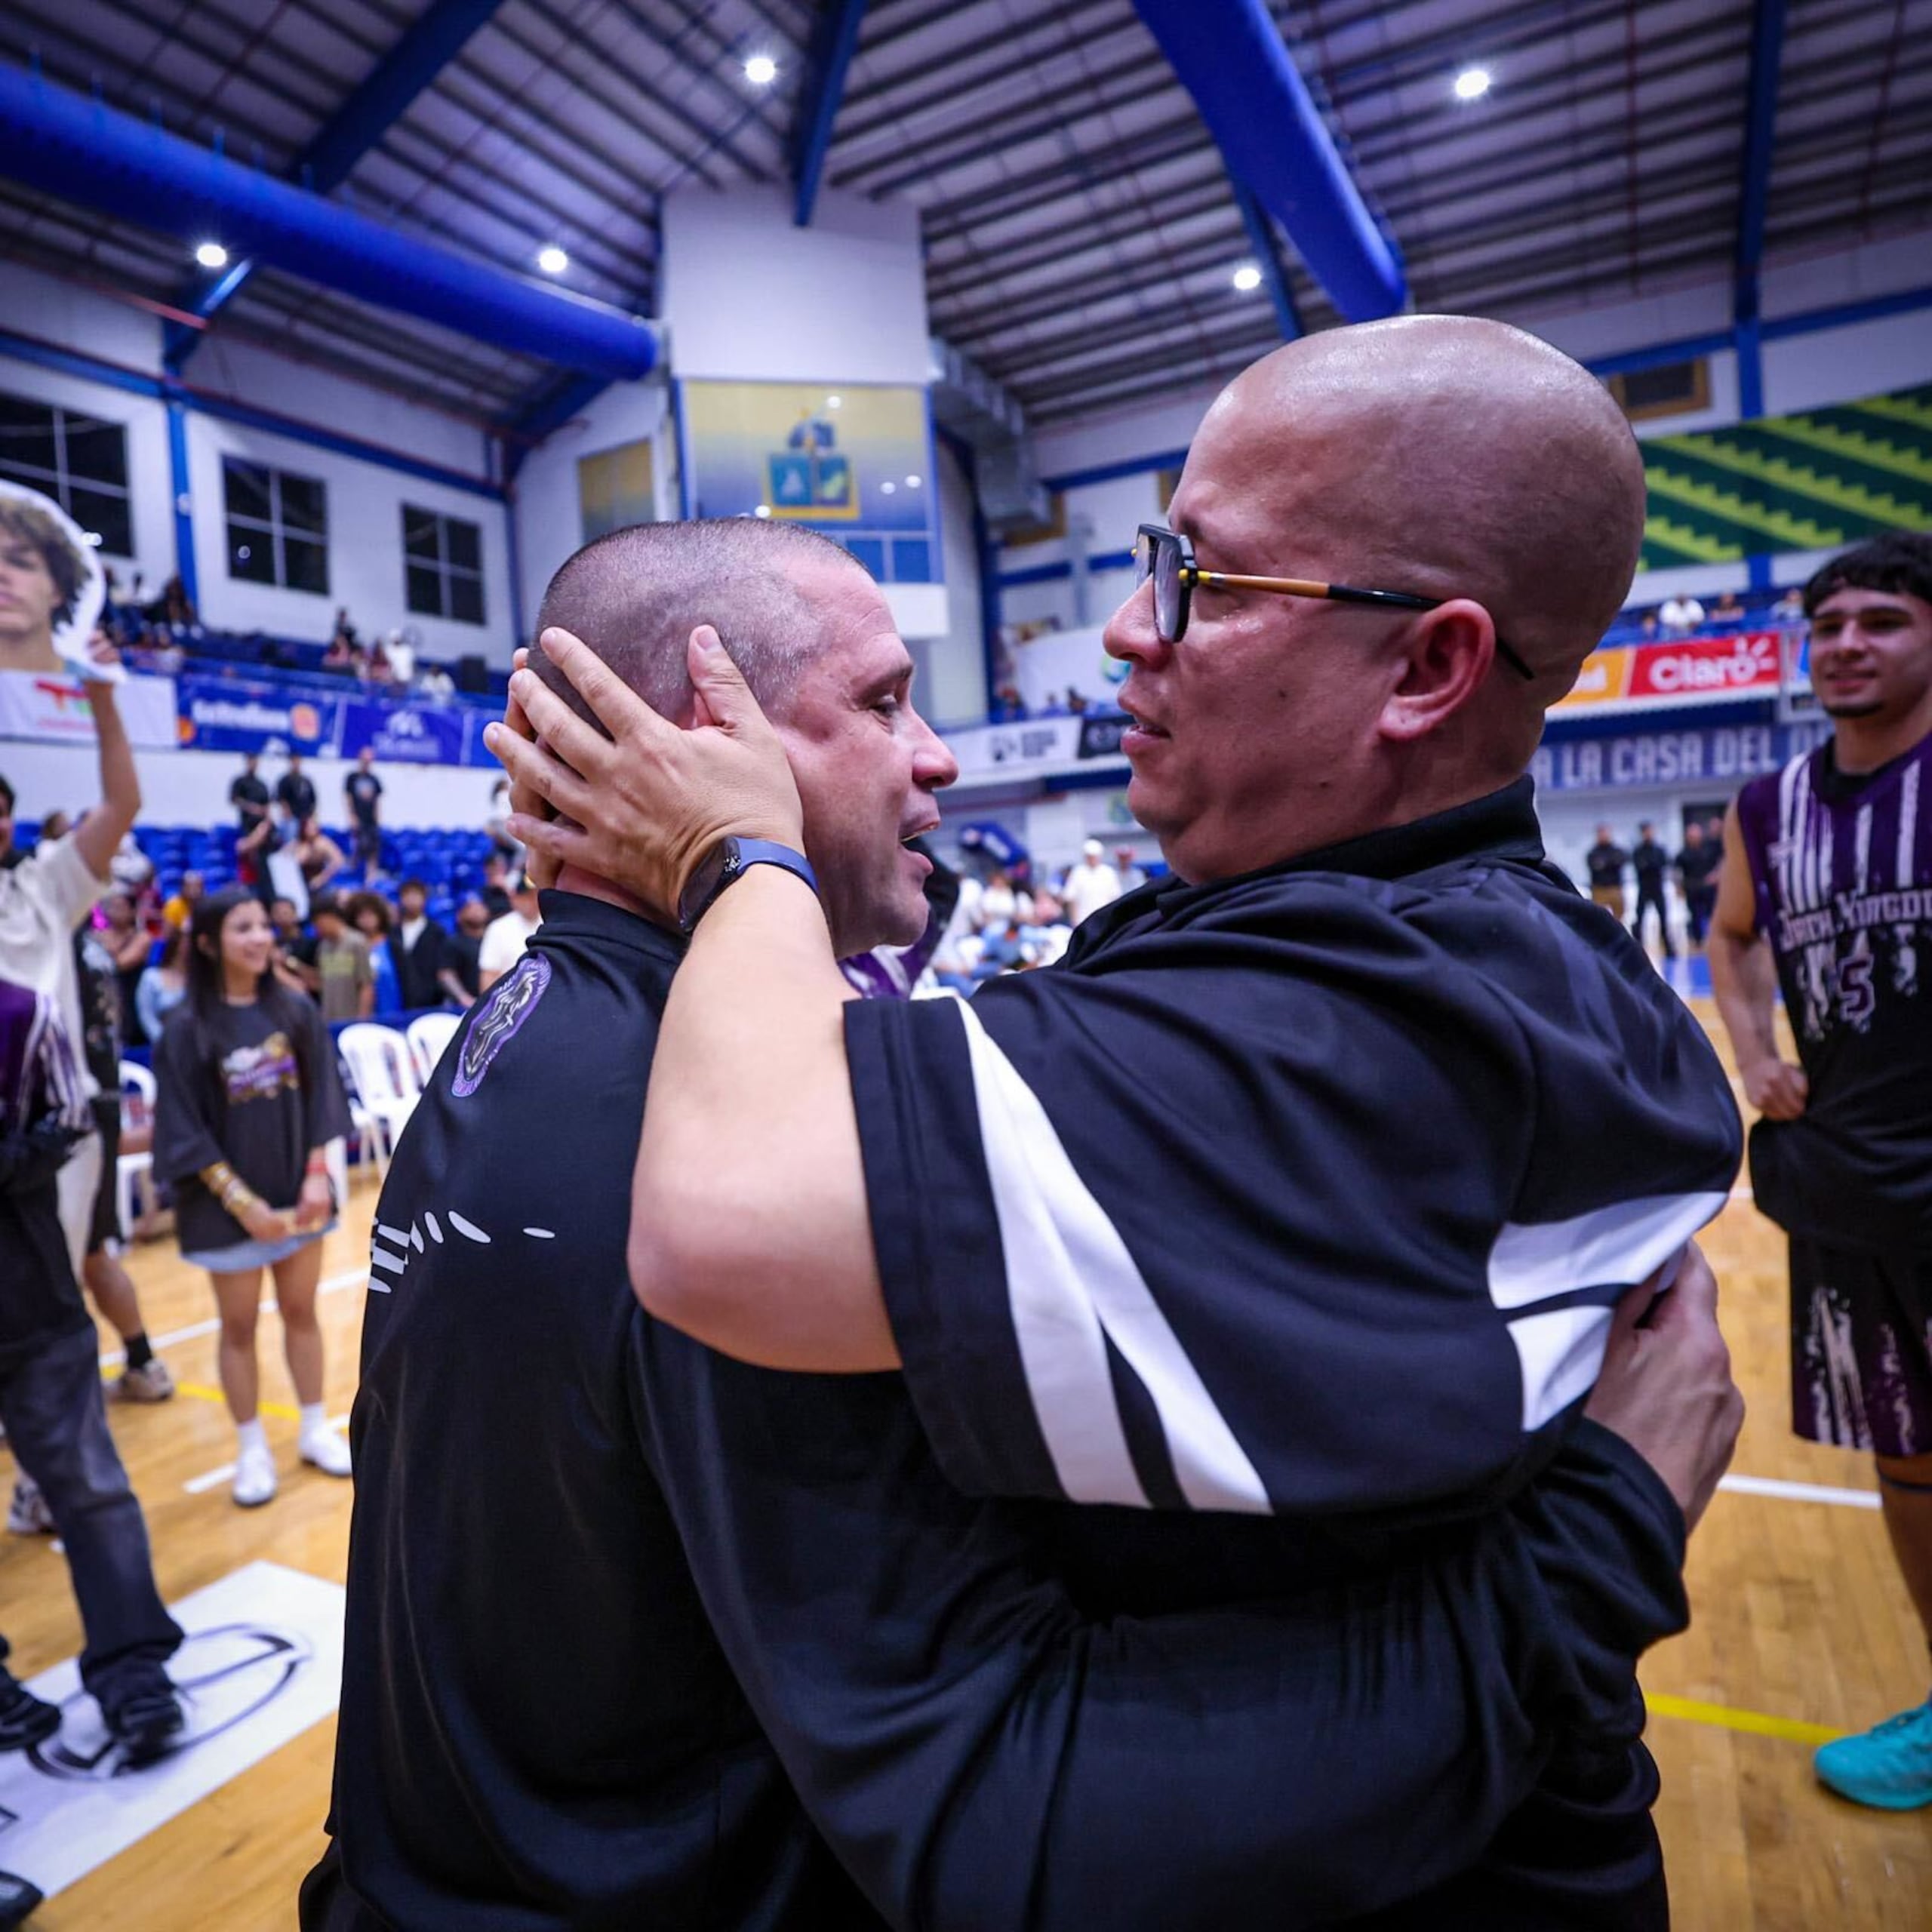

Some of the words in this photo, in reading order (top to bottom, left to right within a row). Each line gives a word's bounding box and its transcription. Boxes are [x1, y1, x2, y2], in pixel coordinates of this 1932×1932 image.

[1649, 652, 1760, 691] Claro
[1561, 741, 1602, 787] LA
[1611, 732, 1703, 783] CASA
[1712, 727, 1778, 776] DEL
